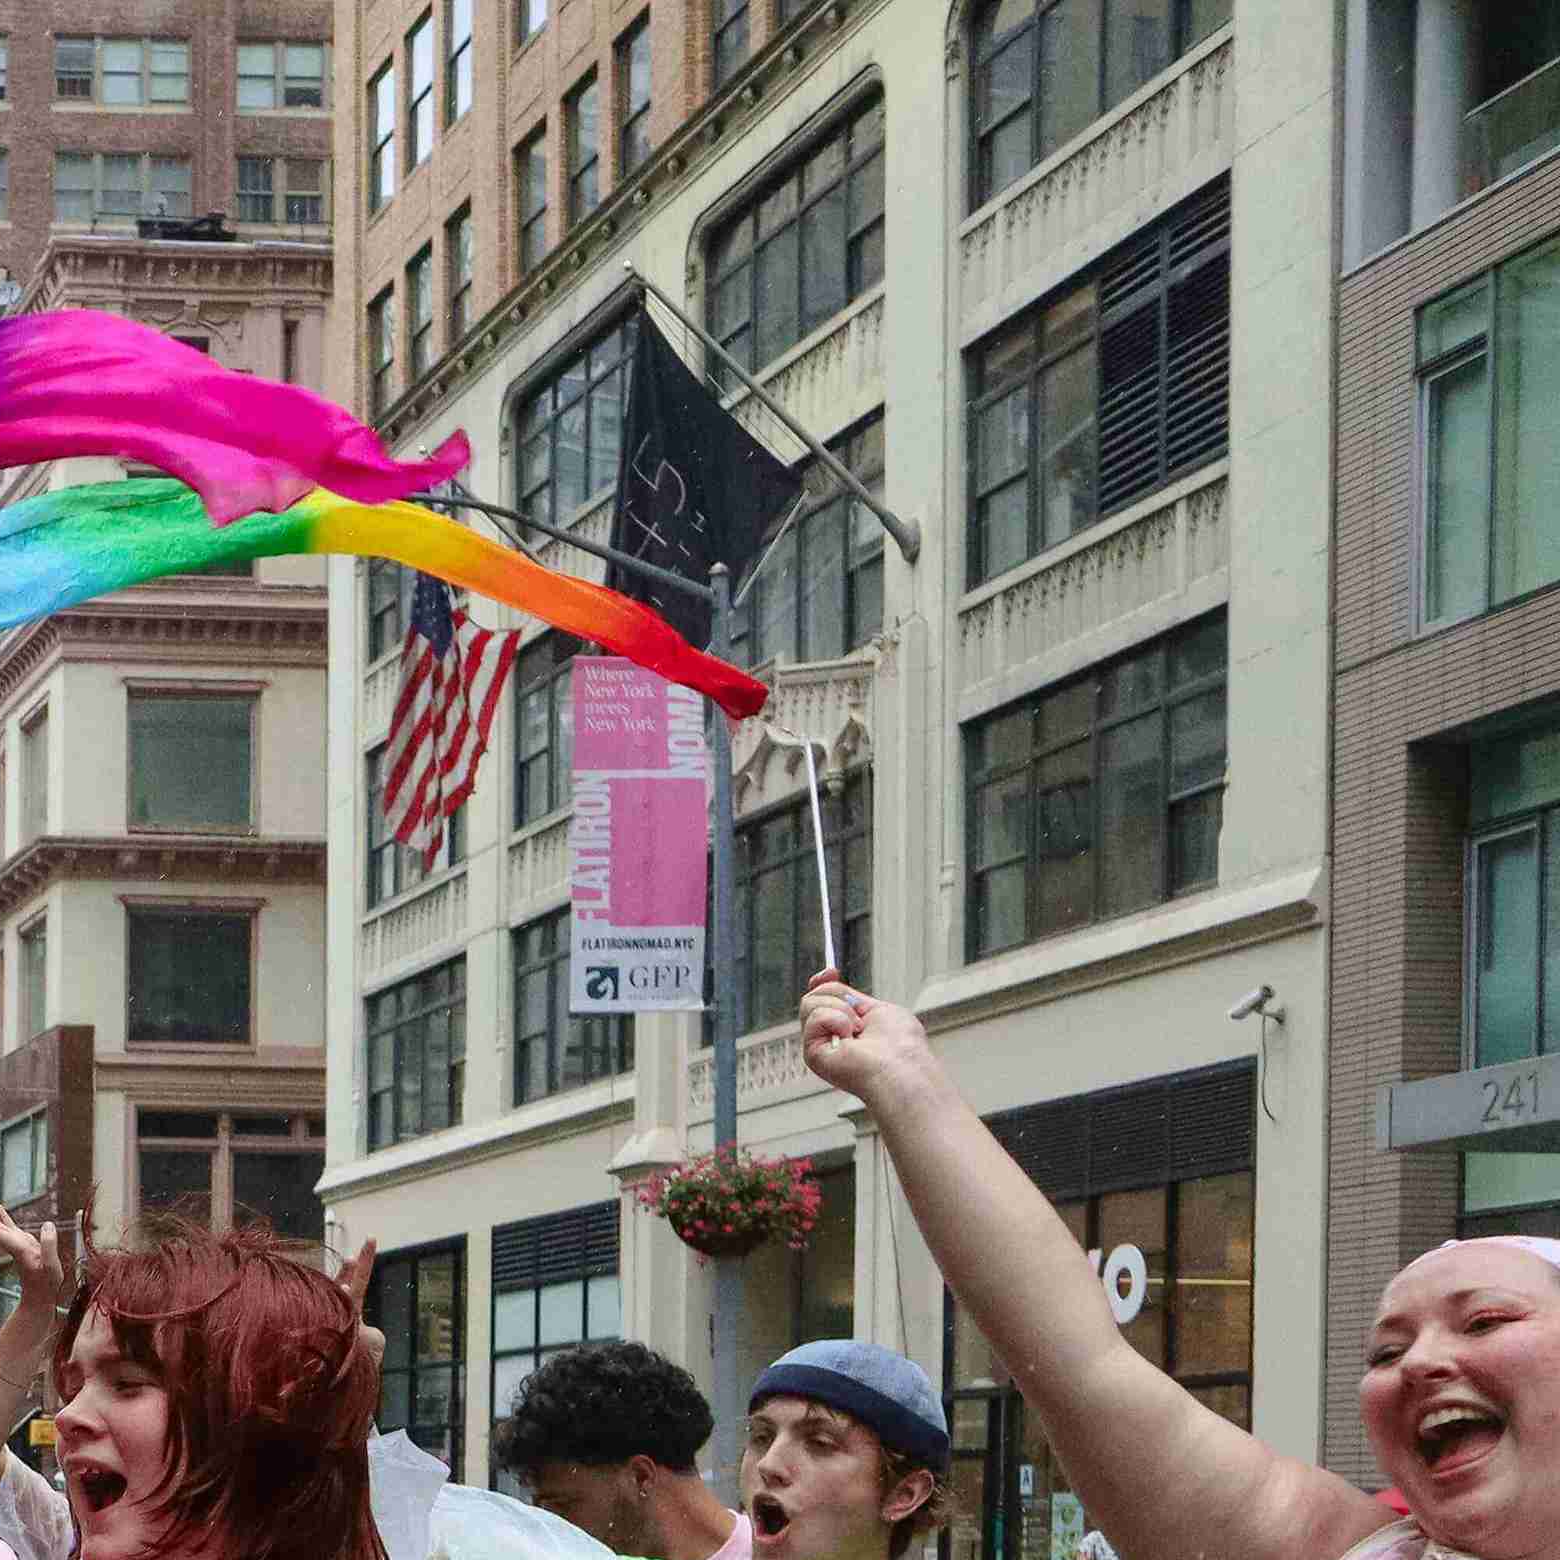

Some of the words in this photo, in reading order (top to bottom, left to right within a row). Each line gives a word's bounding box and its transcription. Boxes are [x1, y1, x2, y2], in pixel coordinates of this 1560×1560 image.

[584, 682, 618, 698] New
[621, 682, 657, 698] York
[584, 716, 618, 732] New
[621, 716, 657, 732] York
[667, 683, 704, 776] NOMA
[570, 779, 610, 925] FLATIRON
[1481, 1071, 1541, 1123] 241
